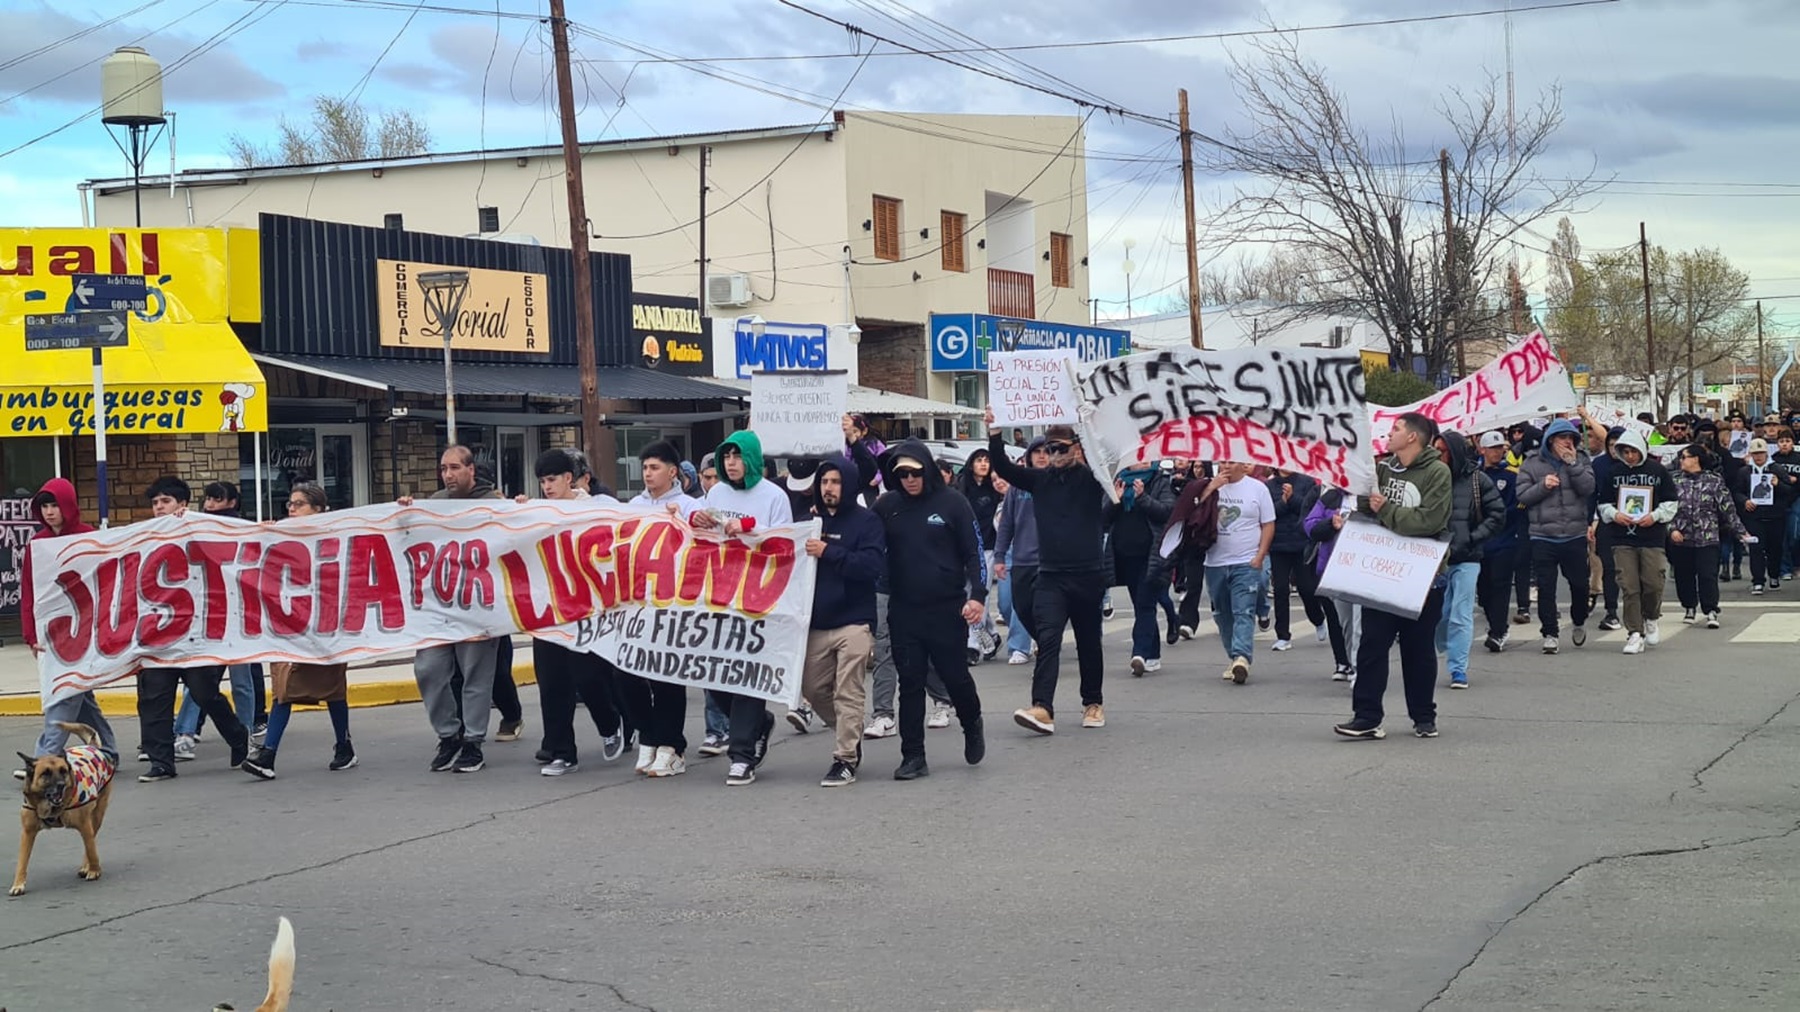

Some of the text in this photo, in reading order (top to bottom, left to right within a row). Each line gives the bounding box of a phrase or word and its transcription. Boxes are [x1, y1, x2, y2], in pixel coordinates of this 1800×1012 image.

[395, 263, 410, 344] COMERCIAL
[523, 275, 536, 349] ESCOLAR
[632, 304, 703, 334] PANADERIA
[61, 337, 80, 348] 100
[736, 330, 825, 372] NATIVOS
[990, 360, 1004, 373] LA
[1500, 334, 1561, 401] POR
[994, 376, 1060, 391] SOCIAL ES
[1005, 391, 1023, 403] LA
[11, 415, 48, 432] en
[404, 539, 495, 612] POR
[625, 606, 646, 640] de
